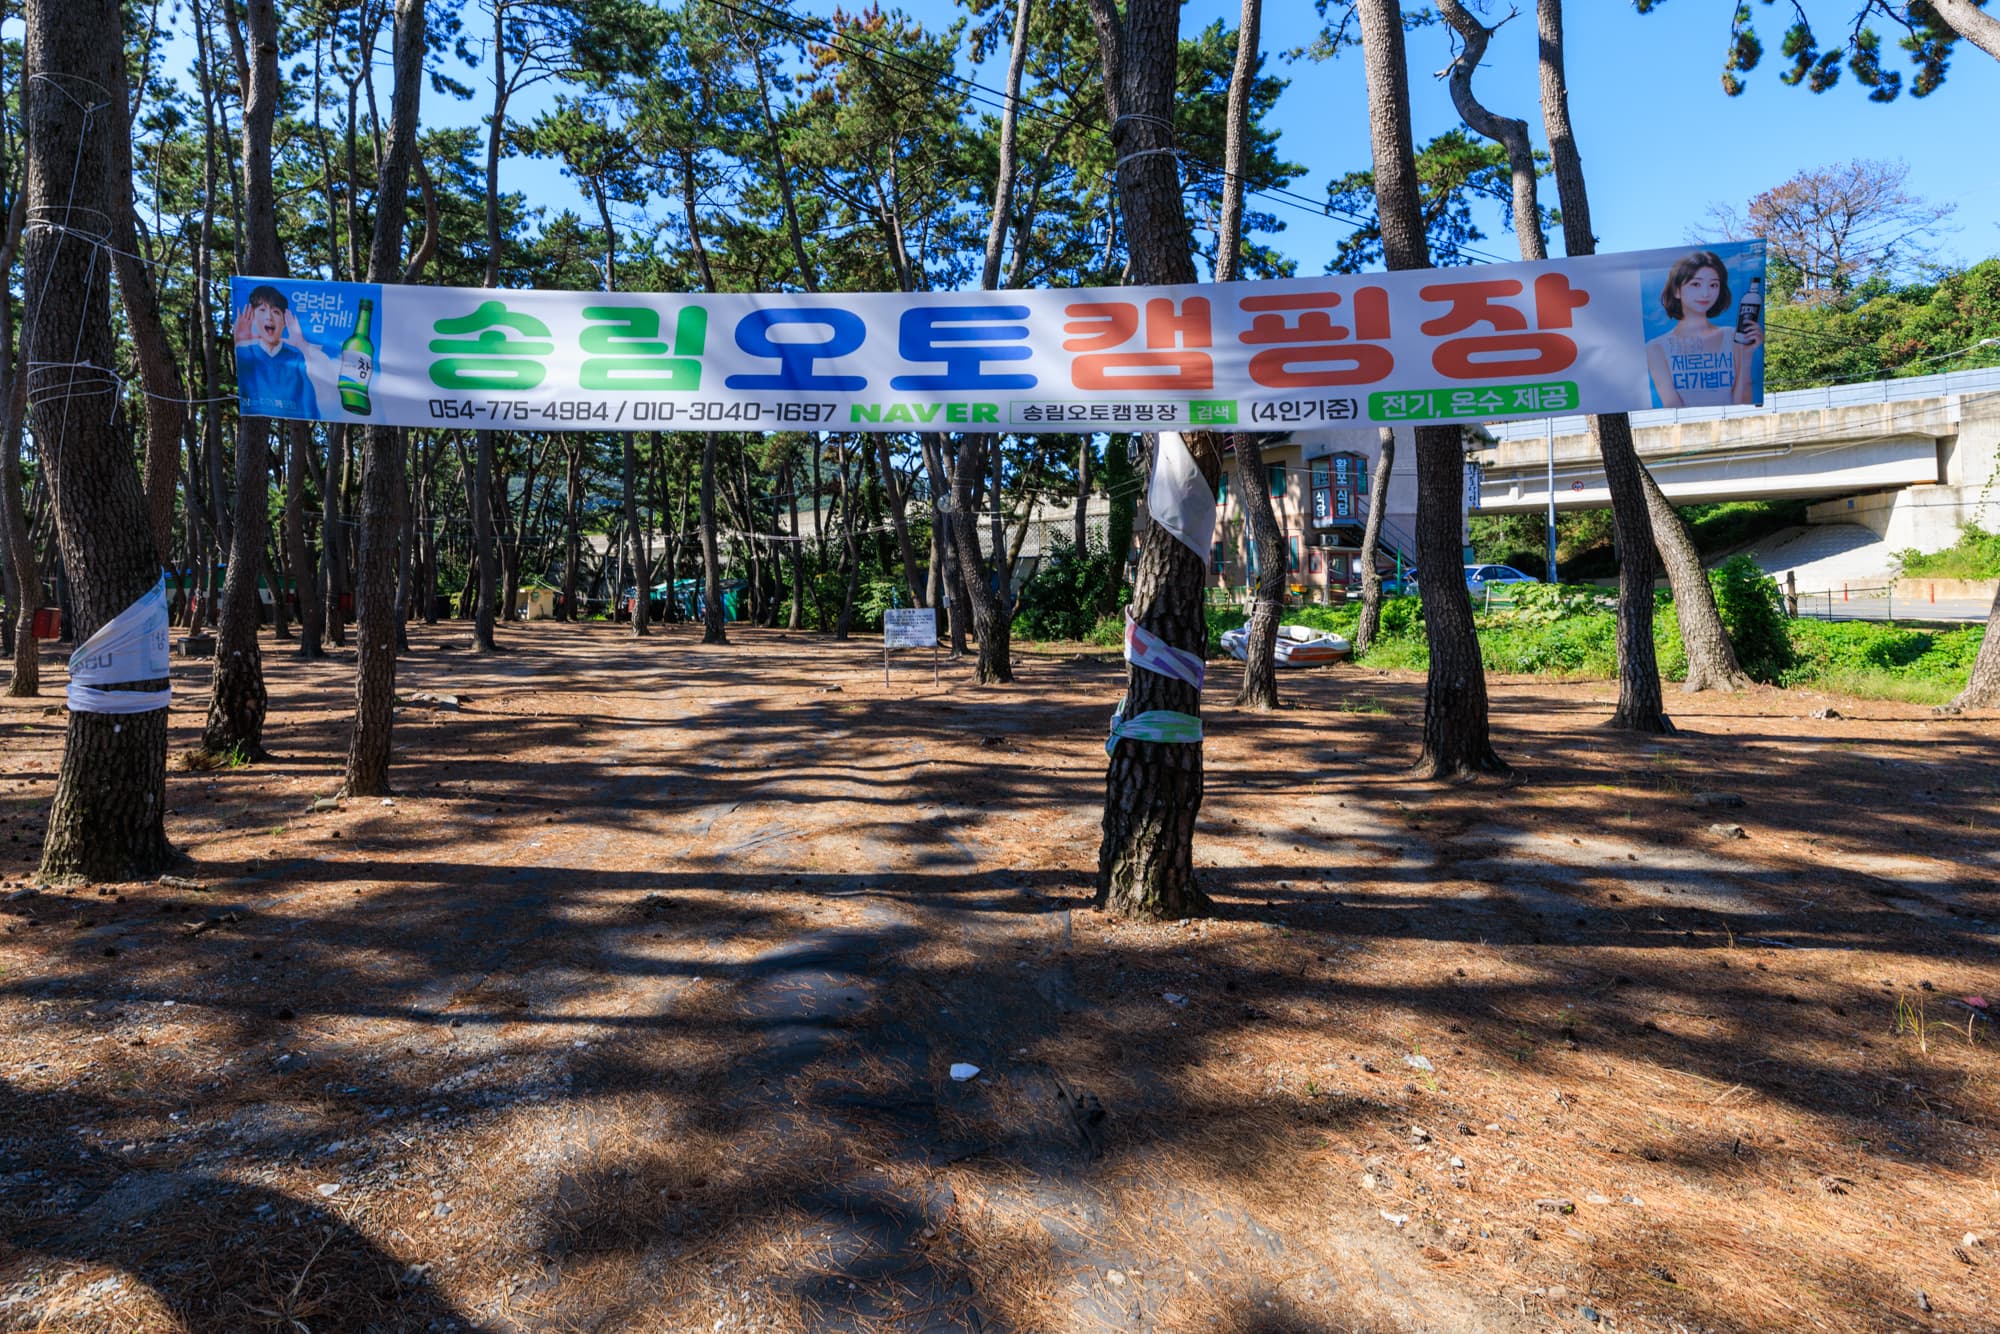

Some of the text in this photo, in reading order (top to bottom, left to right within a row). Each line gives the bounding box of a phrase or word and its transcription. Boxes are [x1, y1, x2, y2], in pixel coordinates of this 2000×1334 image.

[291, 291, 344, 312] 열려라
[309, 309, 353, 334] 참깨!
[358, 357, 371, 379] 참
[1671, 351, 1733, 371] 제로라서
[428, 399, 608, 421] 054-775-4984
[633, 401, 837, 422] 010-3040-1697
[850, 402, 999, 424] NAVER
[1023, 404, 1178, 421] 송림오토캠핑장
[1197, 405, 1230, 421] 검색
[1251, 398, 1358, 422] (4인기준)
[1382, 393, 1442, 419] 전기,
[1450, 391, 1505, 414] 온수
[1512, 385, 1568, 410] 제공
